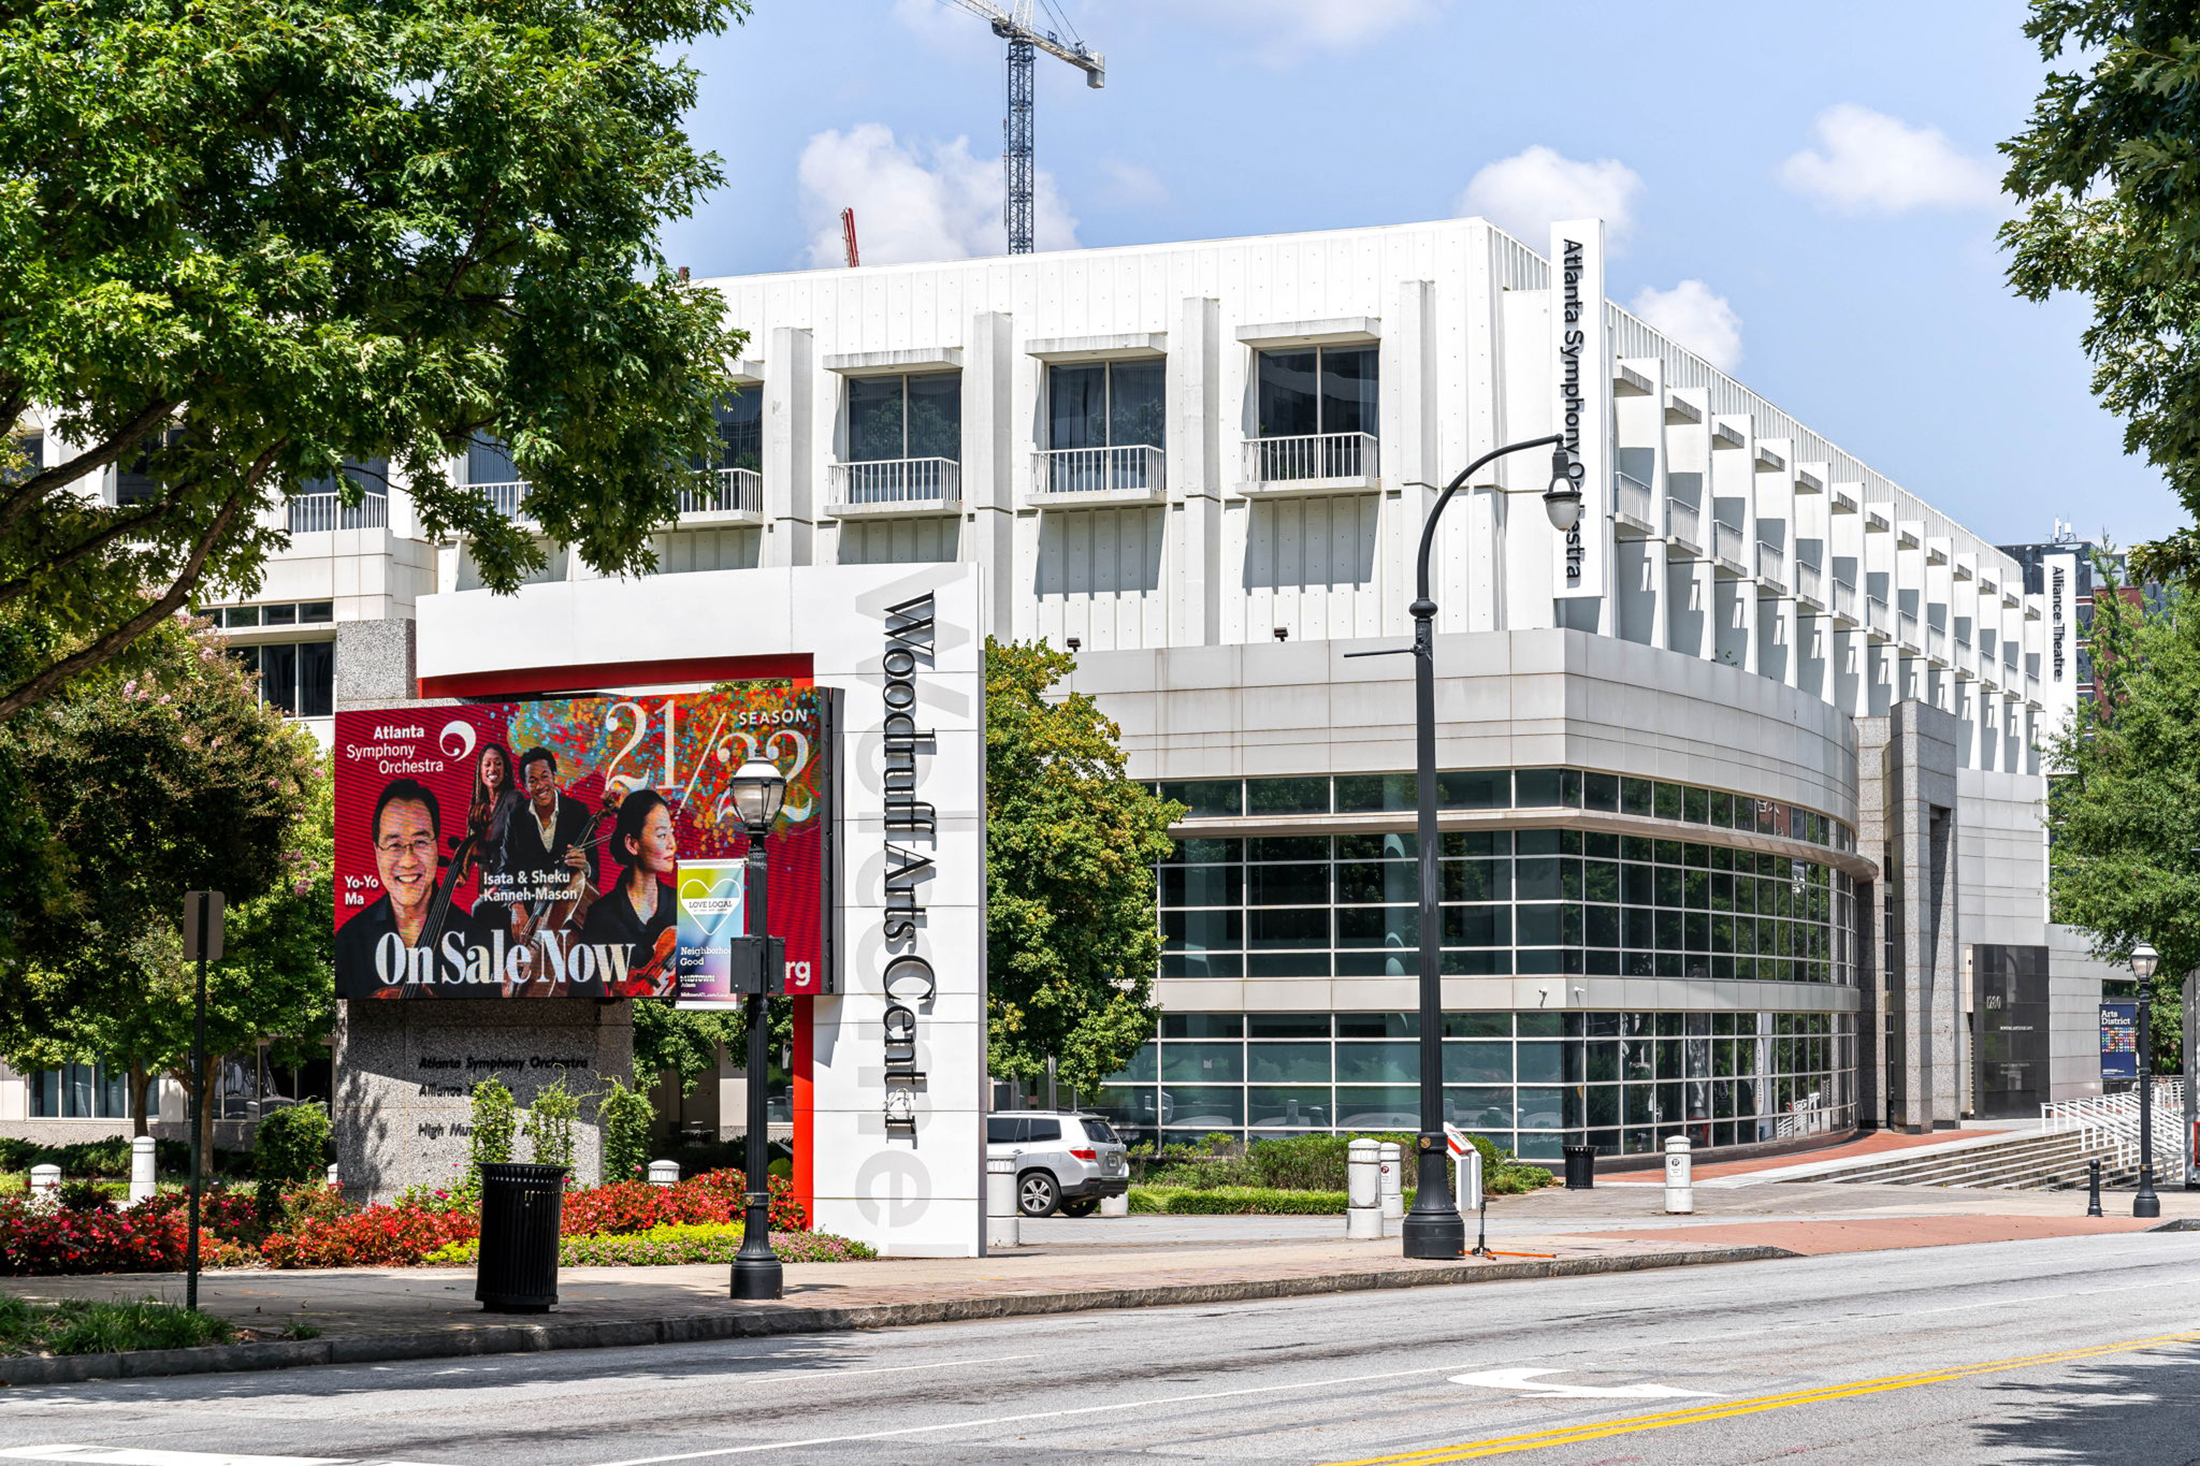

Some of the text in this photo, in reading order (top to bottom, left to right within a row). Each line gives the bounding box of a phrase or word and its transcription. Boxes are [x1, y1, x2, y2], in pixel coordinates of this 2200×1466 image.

[1563, 238, 1583, 323] Atlanta
[1560, 329, 1584, 455] Symphony
[2052, 566, 2066, 677] Alliance Theatre
[738, 708, 808, 726] SEASON
[373, 724, 425, 740] Atlanta
[346, 743, 416, 762] Symphony
[379, 759, 444, 774] Orchestra
[883, 589, 936, 1134] Woodruff Arts Centr
[344, 875, 379, 889] Yo-Yo
[484, 869, 571, 886] Isata & Sheku
[345, 892, 364, 905] Ma
[484, 886, 578, 902] Kanneh-Mason
[688, 900, 732, 909] LOVE LOCAL
[375, 929, 636, 985] On Sale Now
[680, 957, 705, 966] Good
[2101, 1010, 2118, 1018] Arts
[2101, 1017, 2131, 1025] District
[418, 1057, 461, 1069] Atlanta
[466, 1055, 526, 1072] Symphony
[418, 1122, 444, 1140] High
